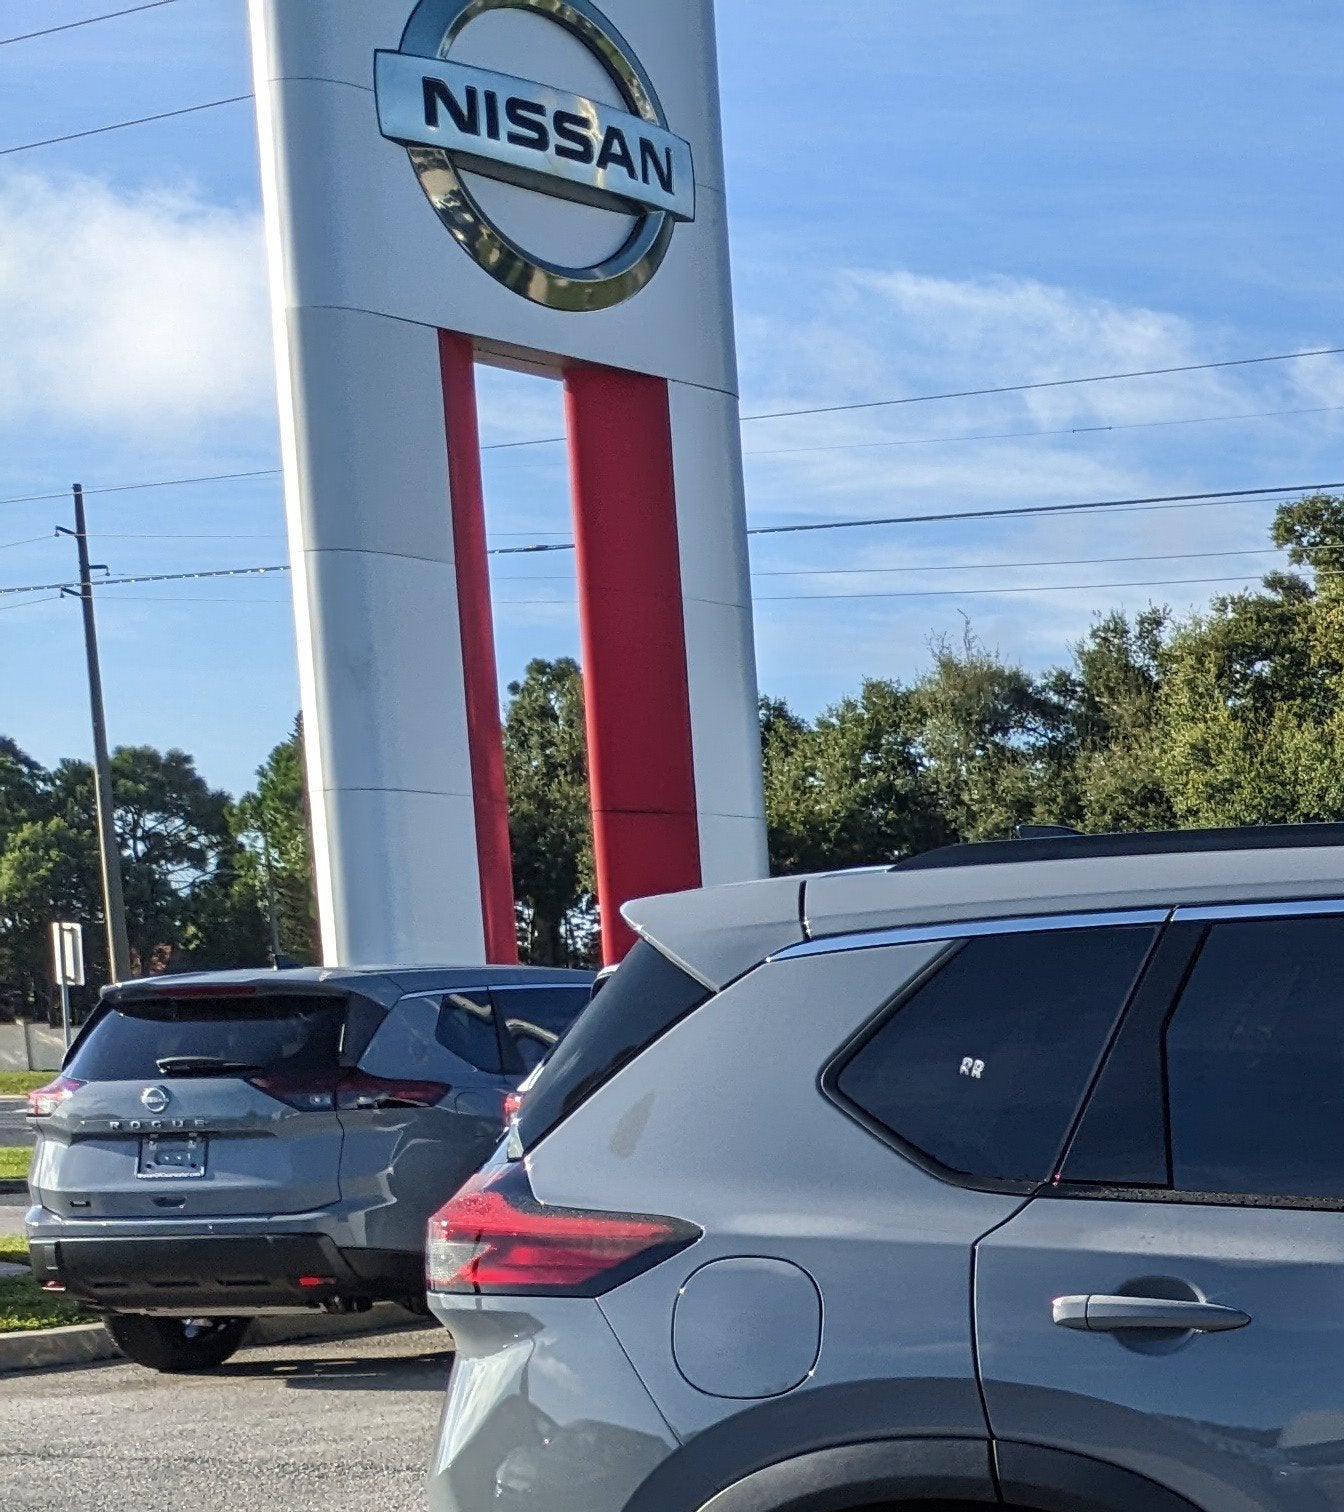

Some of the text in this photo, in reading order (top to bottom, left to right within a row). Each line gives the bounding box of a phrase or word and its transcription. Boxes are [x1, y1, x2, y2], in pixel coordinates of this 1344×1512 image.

[421, 75, 675, 196] NISSAN
[959, 1056, 985, 1079] RR
[109, 1119, 205, 1131] ROGUE
